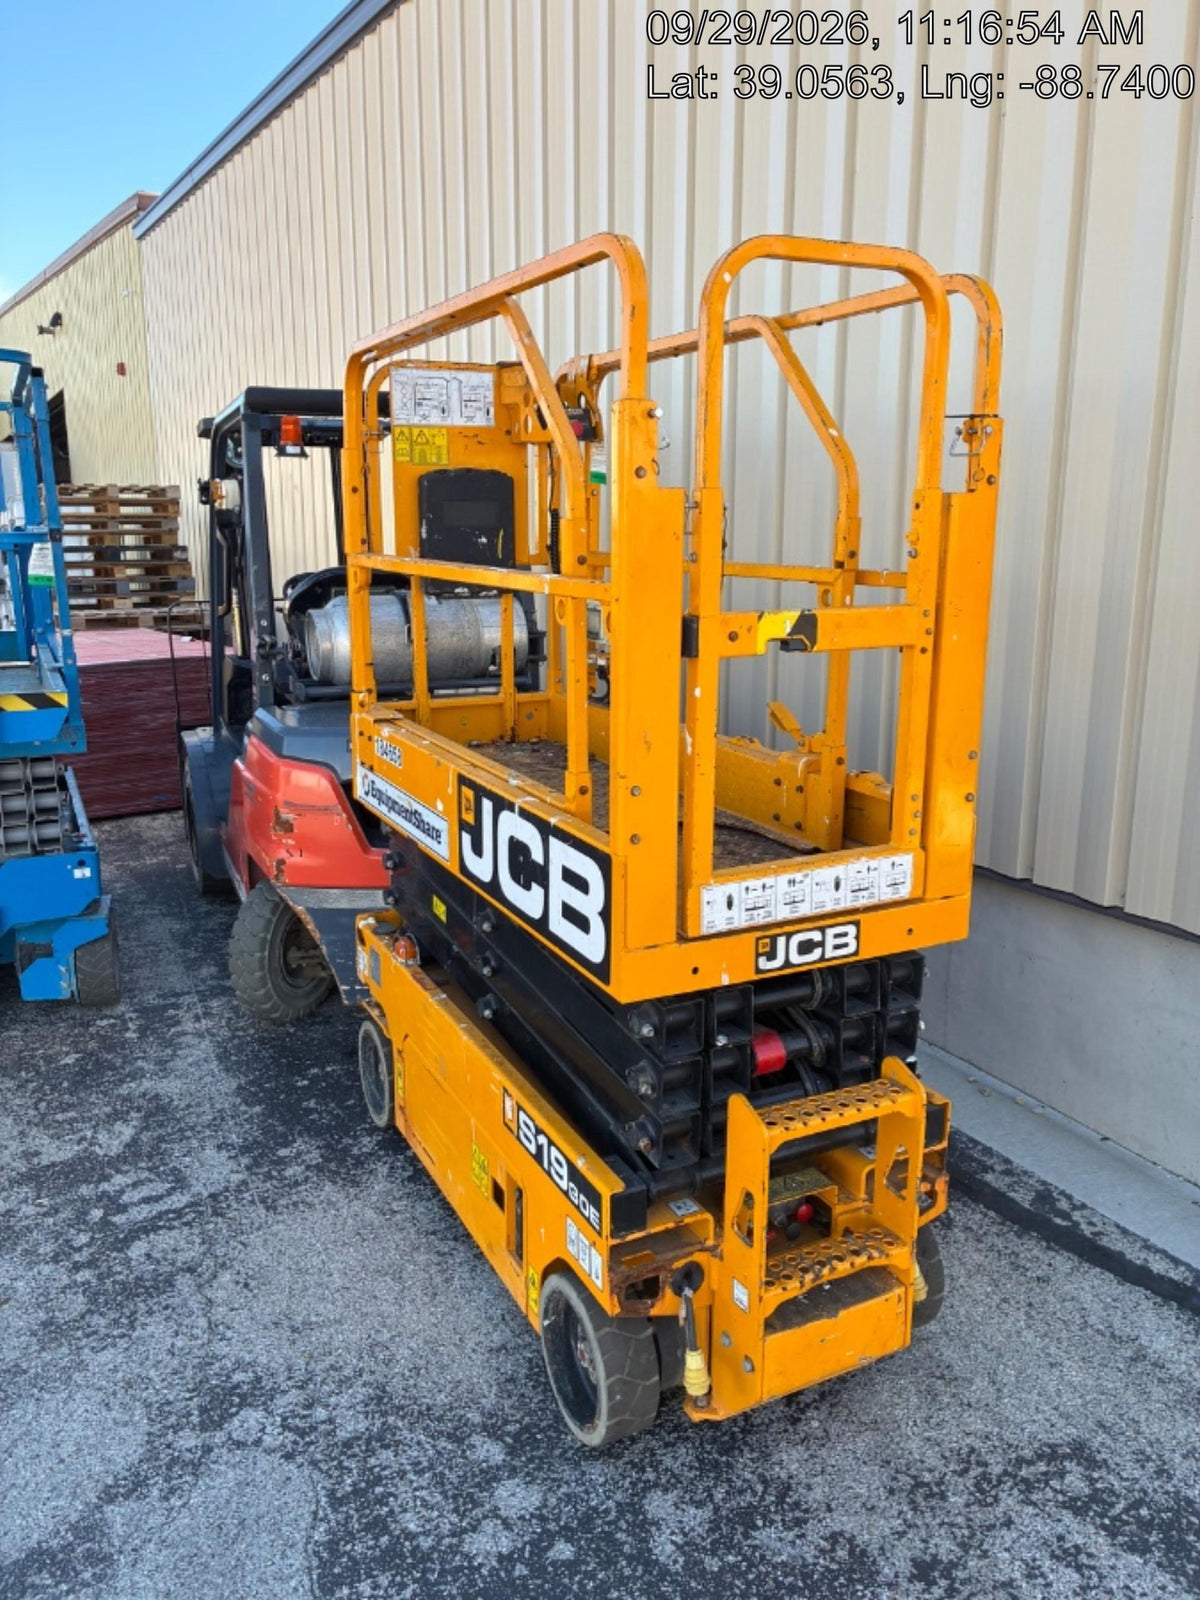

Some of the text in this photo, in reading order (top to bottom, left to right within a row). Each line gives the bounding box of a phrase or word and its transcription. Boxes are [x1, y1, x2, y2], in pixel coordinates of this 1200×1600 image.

[370, 779, 443, 846] EquipmentShare
[461, 796, 606, 965] JCB
[757, 923, 858, 970] JCB
